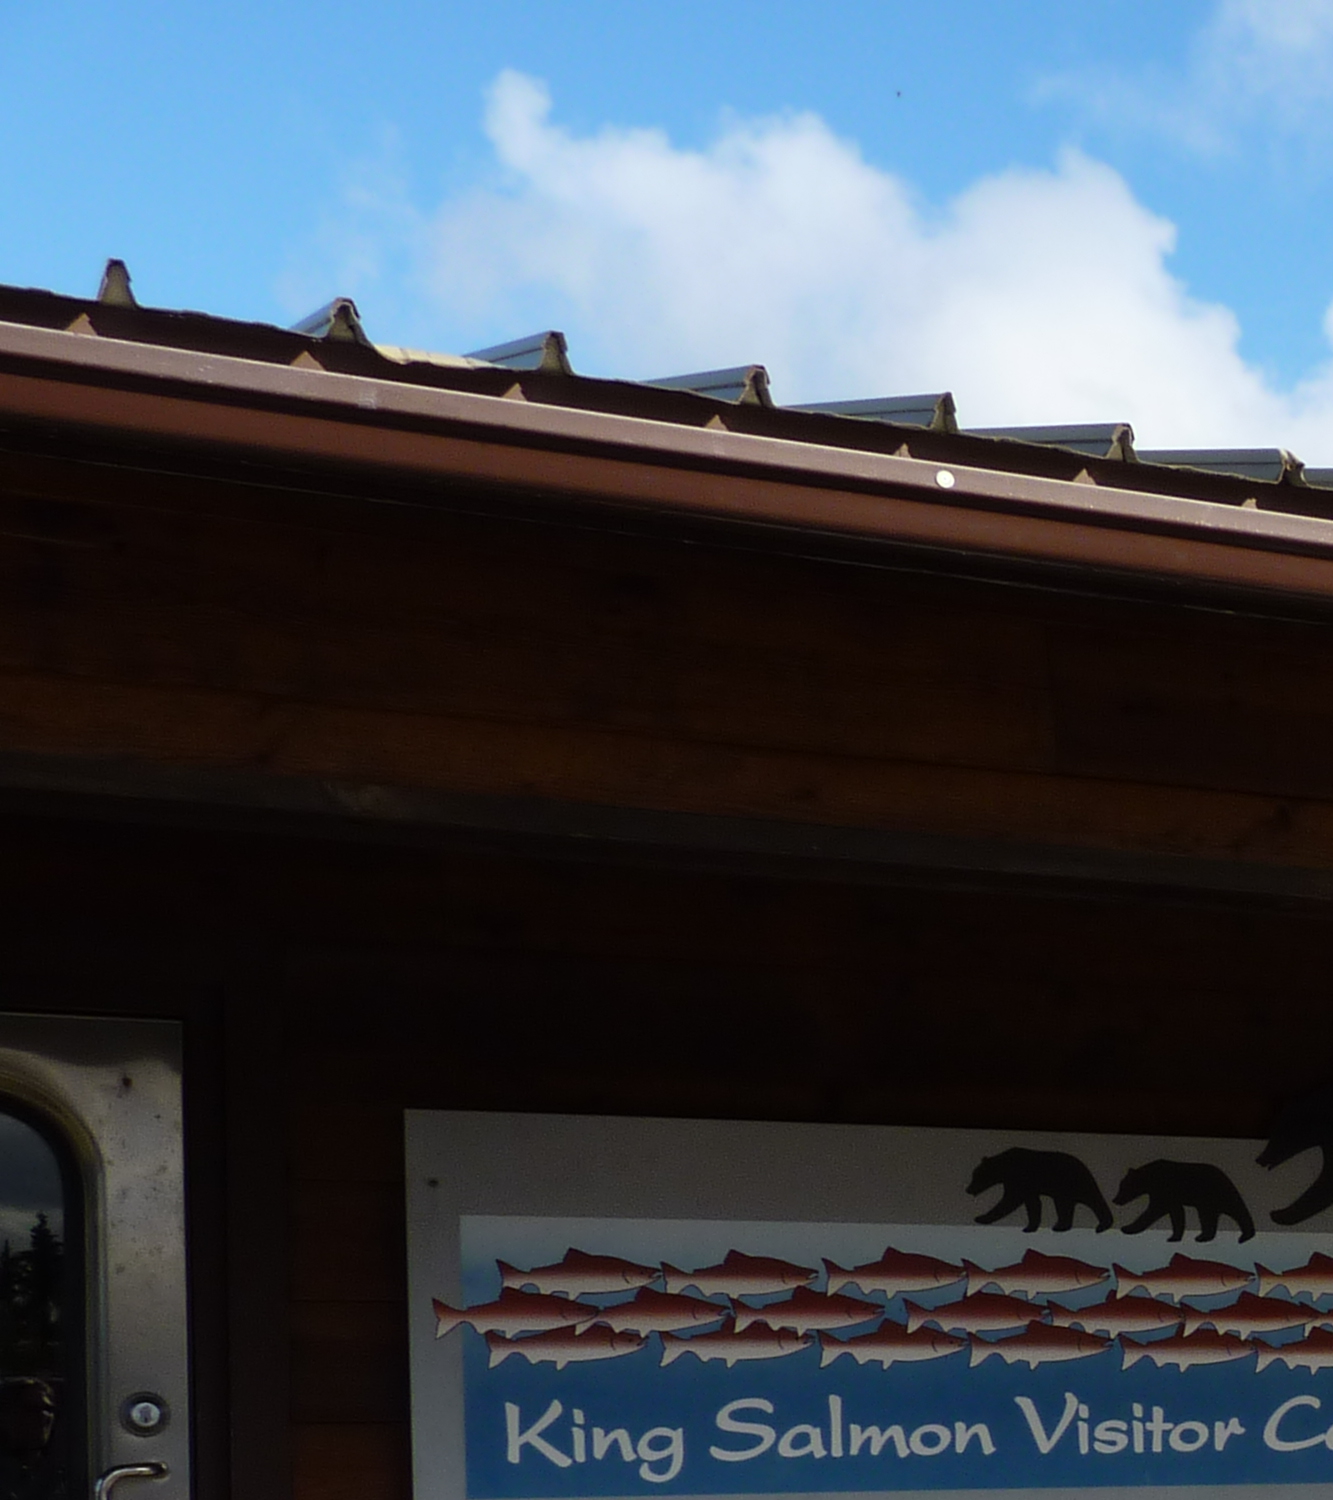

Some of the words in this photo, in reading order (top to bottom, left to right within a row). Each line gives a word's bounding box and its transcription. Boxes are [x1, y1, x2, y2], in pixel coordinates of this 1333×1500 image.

[505, 1399, 685, 1483] King
[710, 1394, 997, 1462] Salmon
[1014, 1392, 1246, 1455] Visitor
